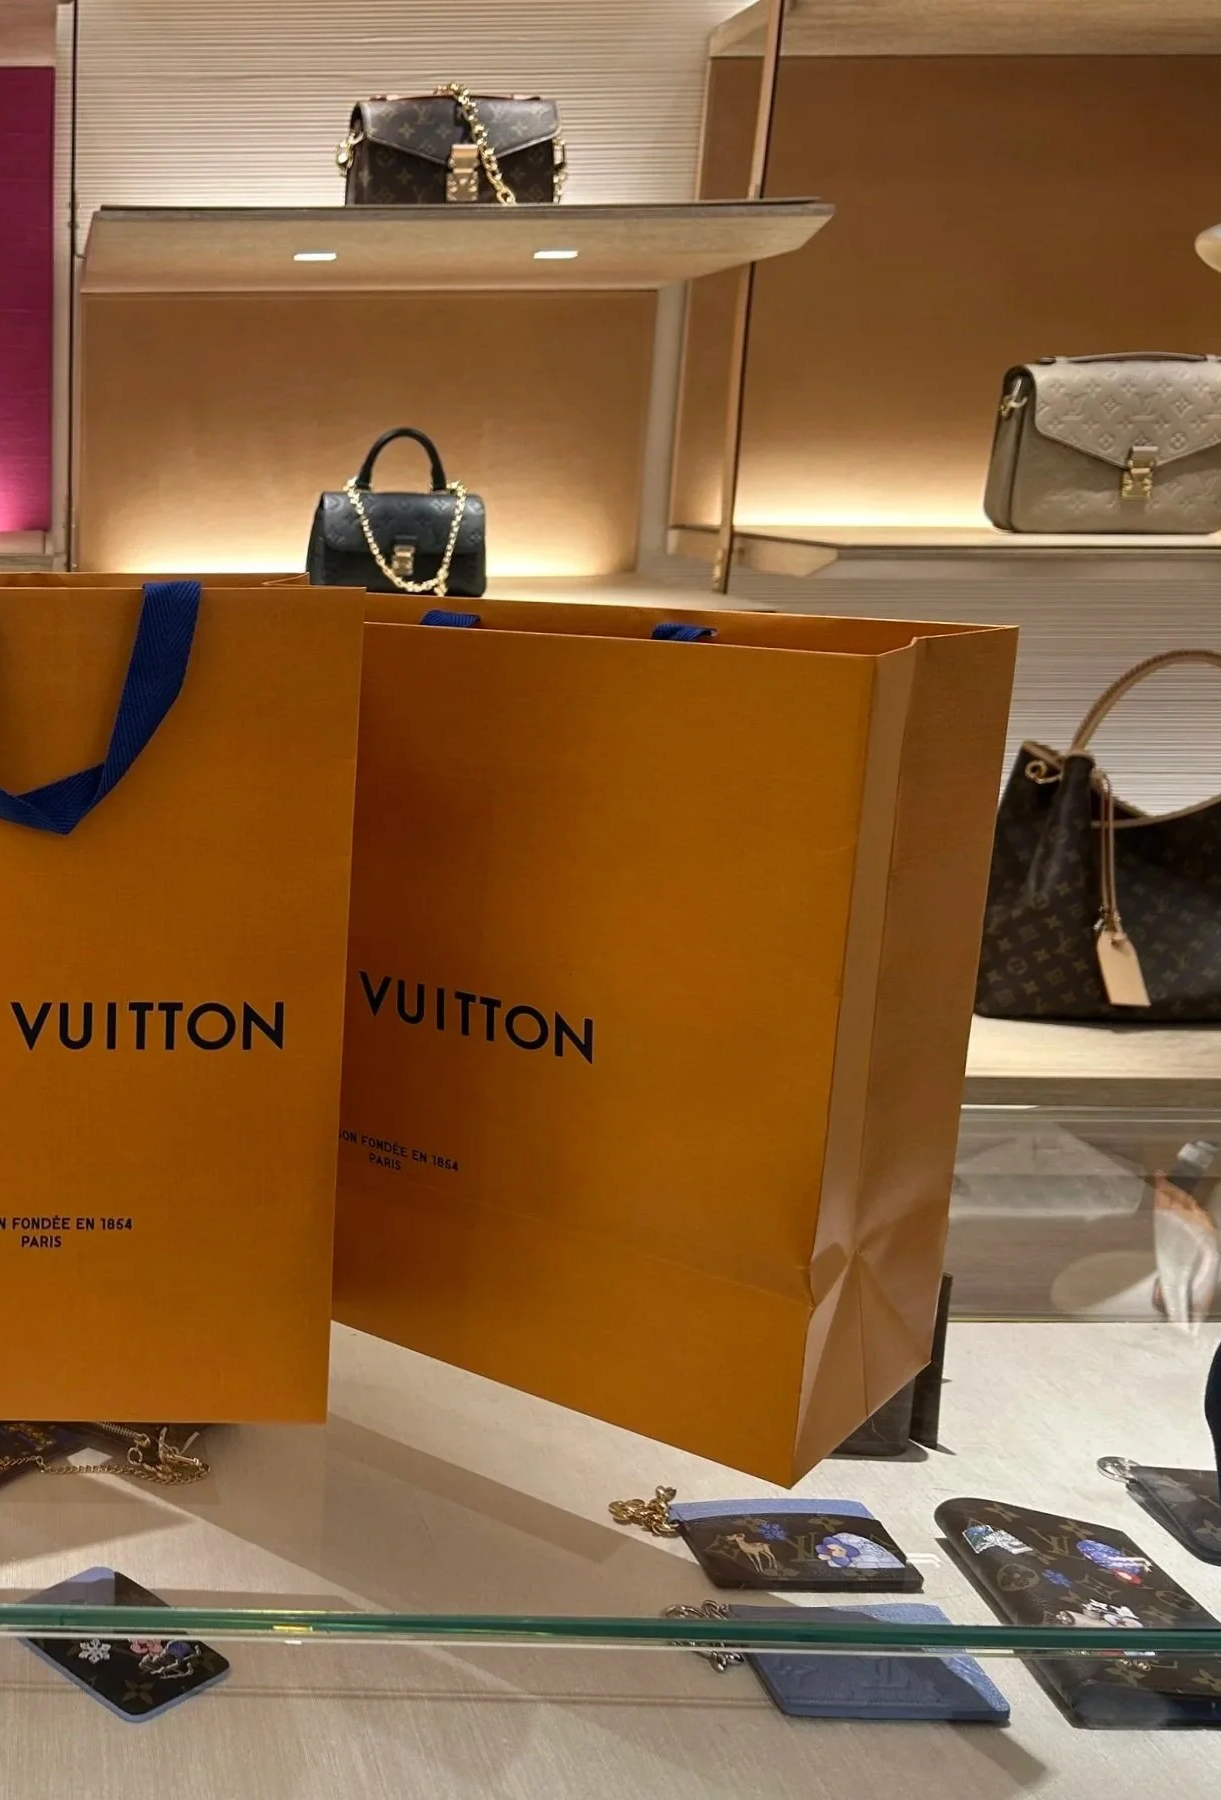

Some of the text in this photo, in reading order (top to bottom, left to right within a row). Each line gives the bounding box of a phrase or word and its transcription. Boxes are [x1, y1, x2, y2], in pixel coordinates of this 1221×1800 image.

[11, 1001, 286, 1051] VUITTON
[358, 970, 594, 1065] VUITTON
[361, 1135, 408, 1158] FONDÉE
[411, 1149, 428, 1164] EN
[369, 1153, 402, 1171] PARIS
[12, 1215, 71, 1230] FONDÉE
[76, 1218, 95, 1230] EN
[21, 1235, 62, 1248] PARIS
